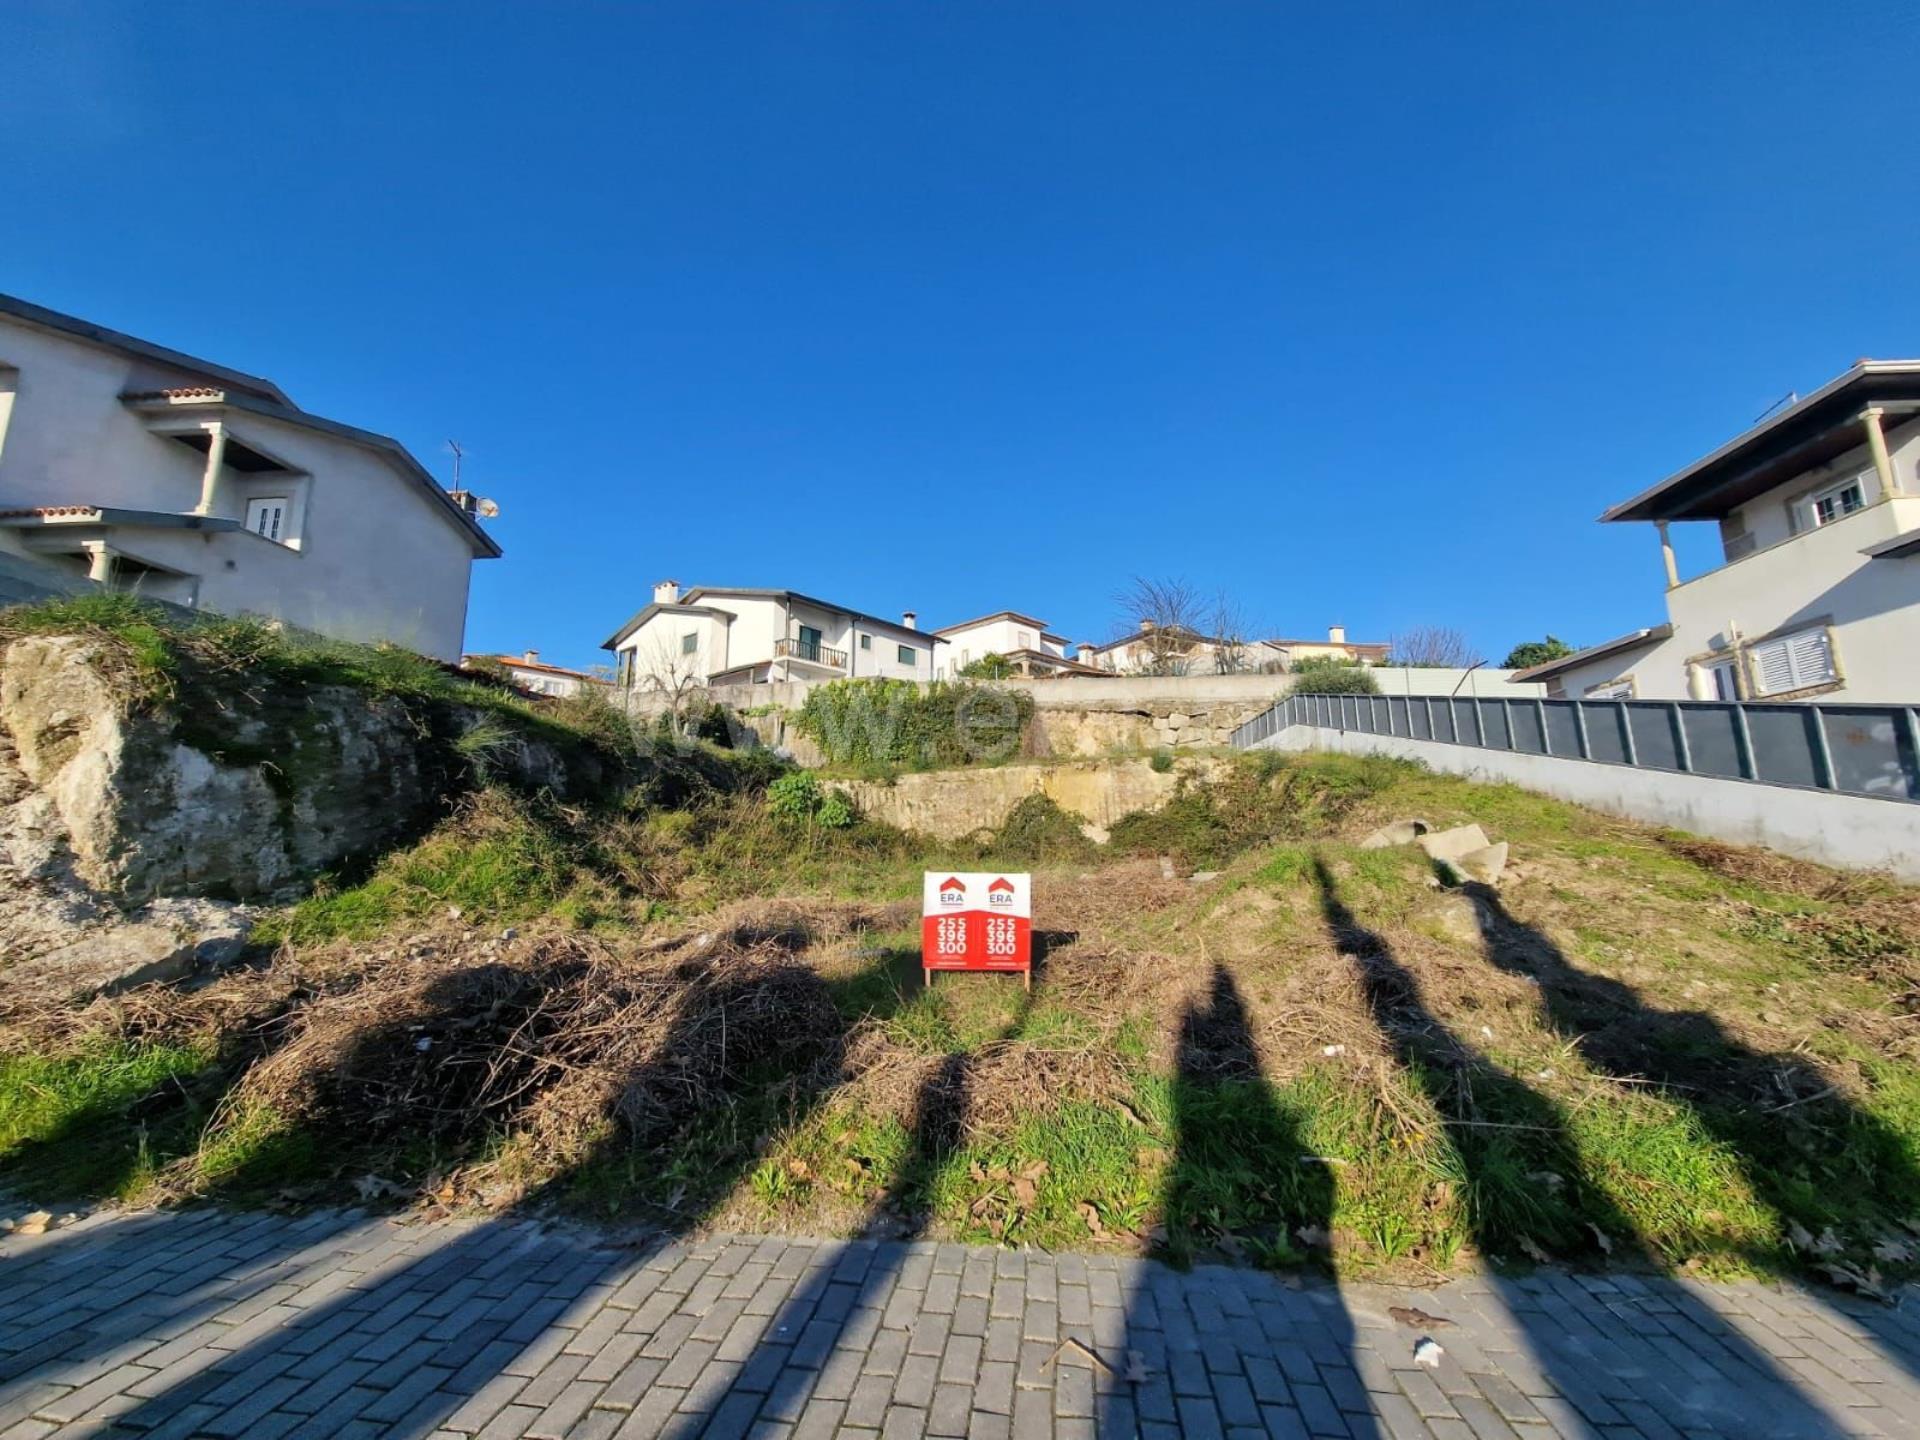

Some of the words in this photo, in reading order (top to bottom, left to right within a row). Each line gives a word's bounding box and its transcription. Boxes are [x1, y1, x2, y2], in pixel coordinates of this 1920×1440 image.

[940, 893, 964, 903] ERA
[989, 894, 1013, 903] ERA
[937, 917, 966, 930] 255
[987, 918, 1015, 930] 255
[937, 930, 966, 942] 396
[987, 930, 1015, 942] 396
[937, 942, 967, 954] 300
[987, 942, 1016, 955] 300
